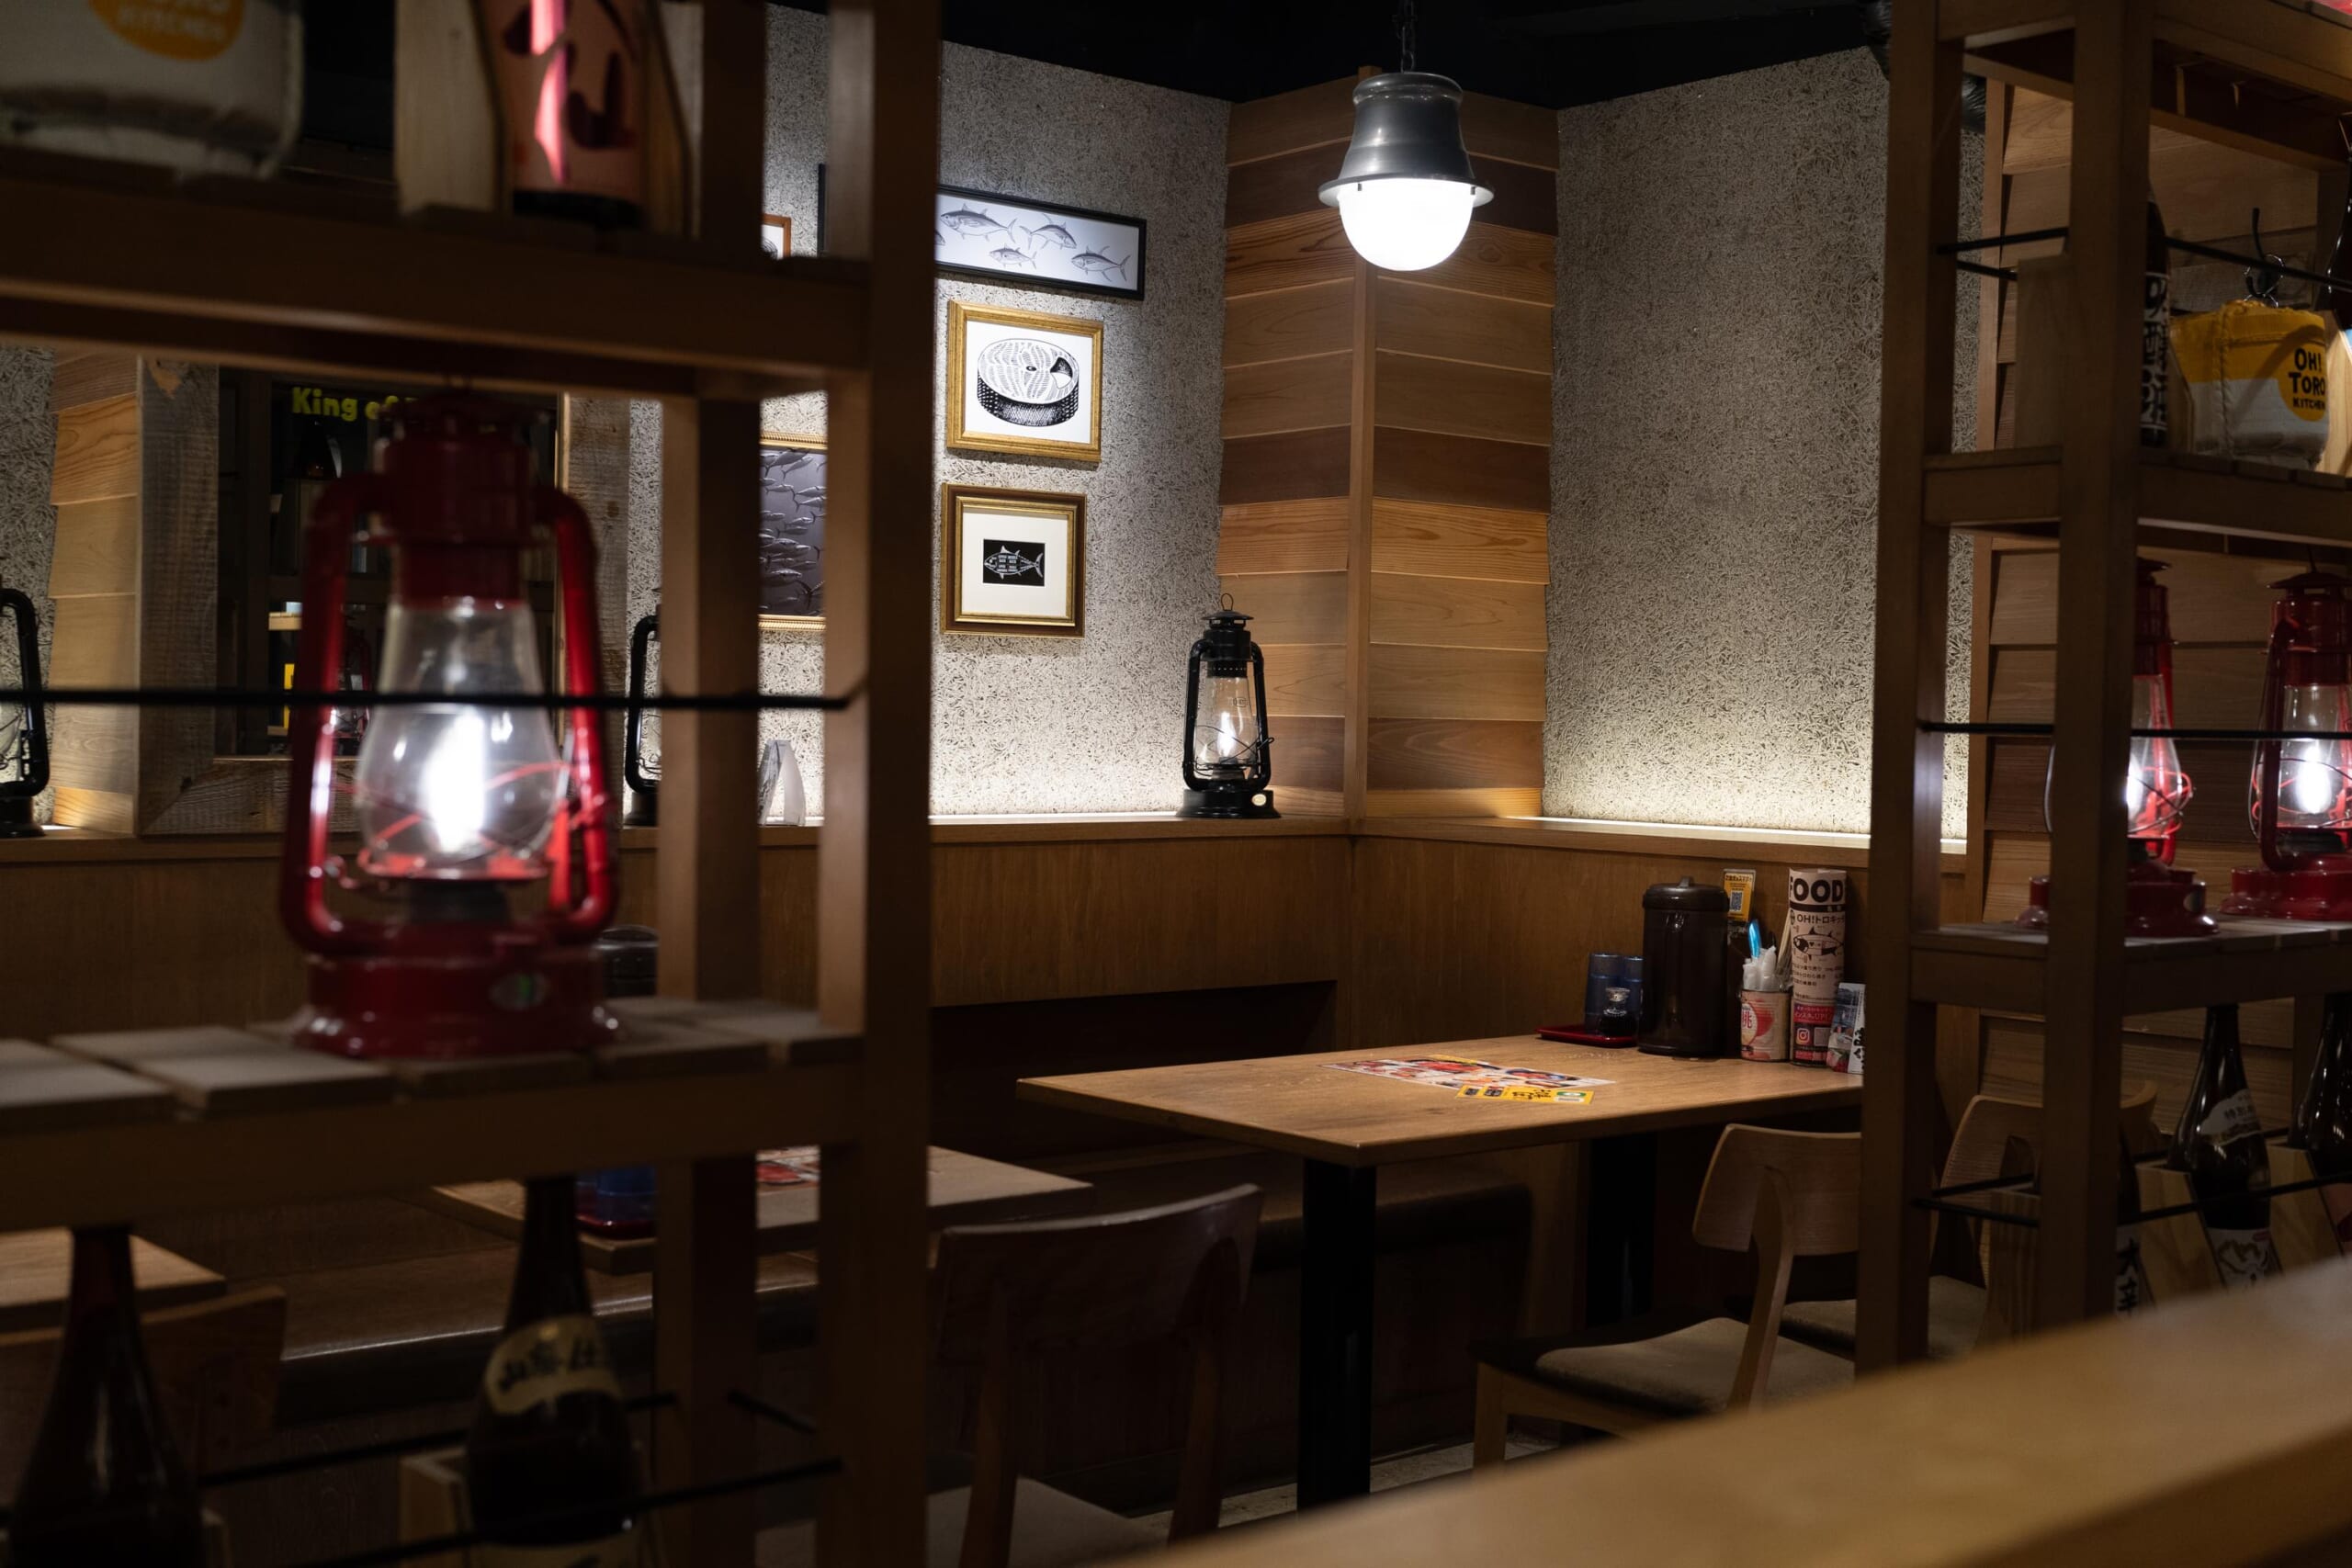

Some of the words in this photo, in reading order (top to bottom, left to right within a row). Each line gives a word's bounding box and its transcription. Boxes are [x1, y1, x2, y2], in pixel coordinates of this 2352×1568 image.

[2294, 347, 2322, 372] OH!
[2288, 371, 2326, 396] TORO
[291, 384, 357, 422] King
